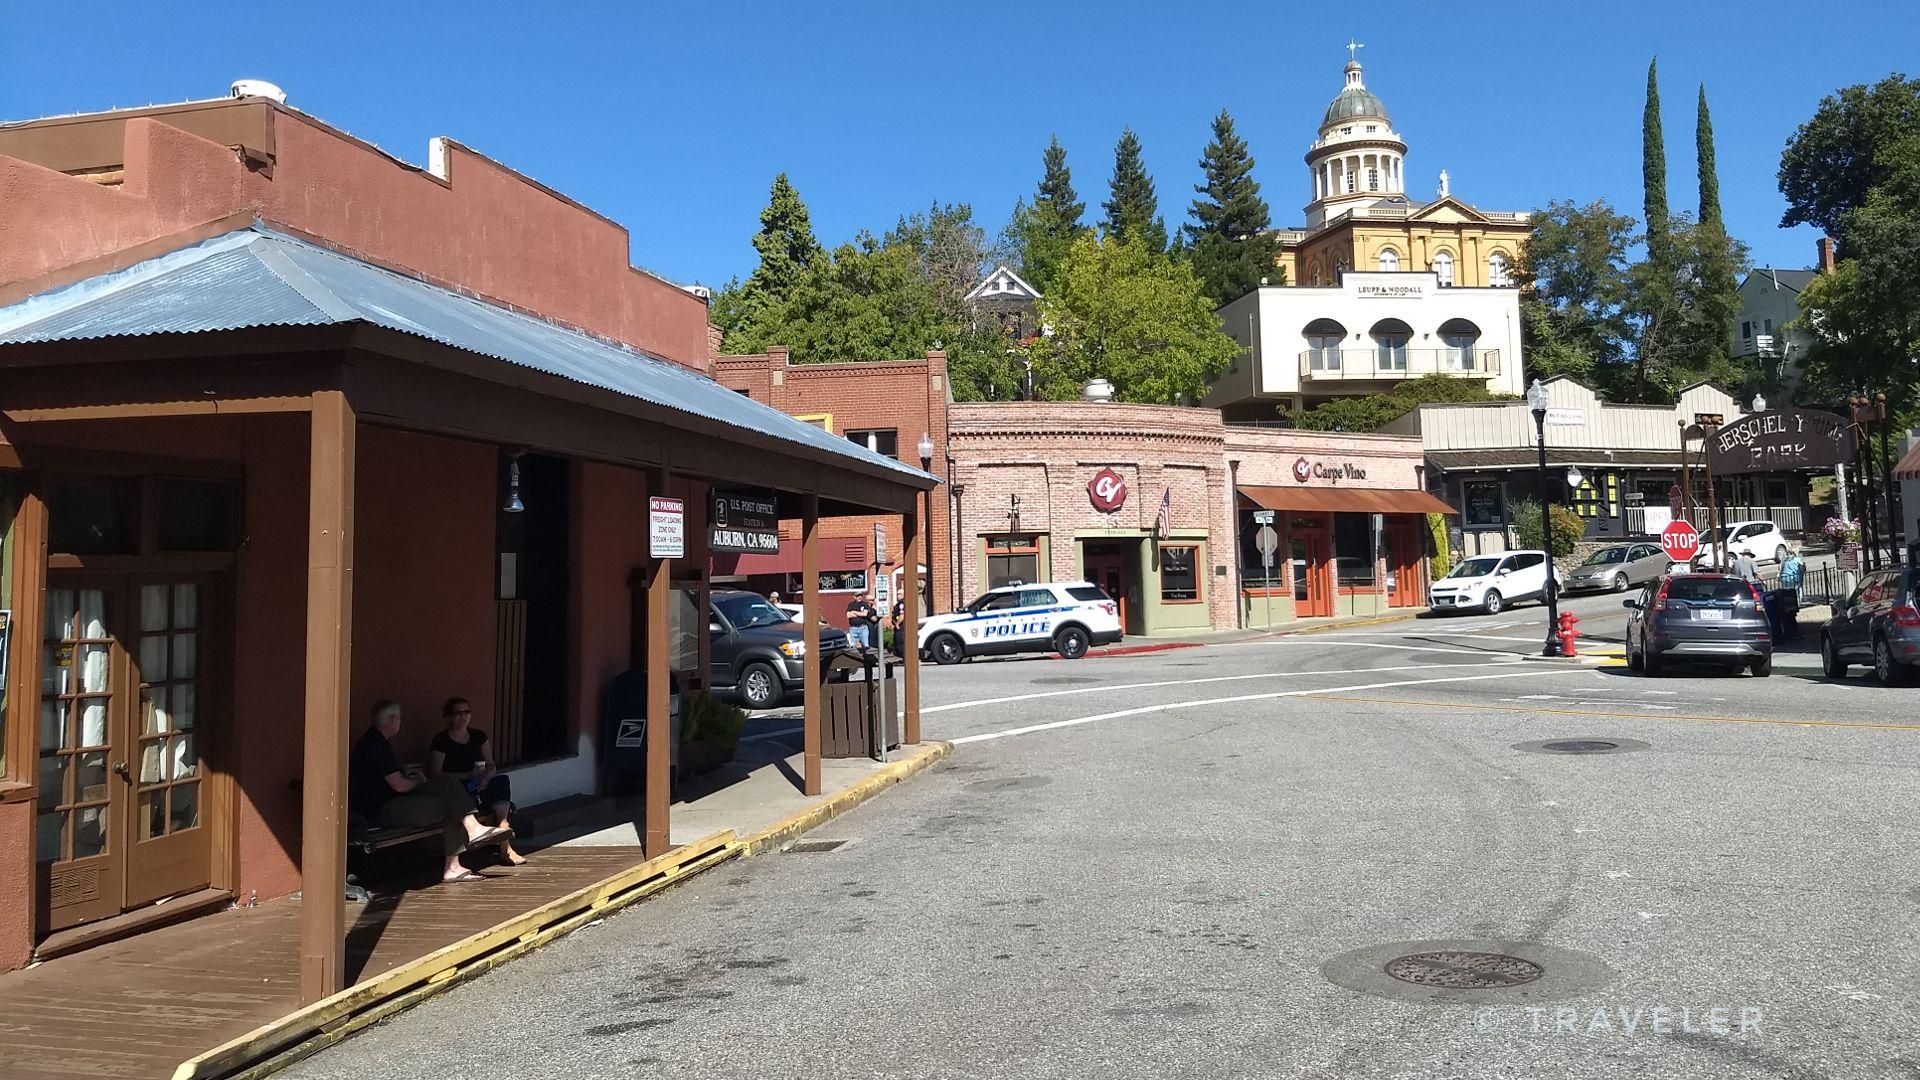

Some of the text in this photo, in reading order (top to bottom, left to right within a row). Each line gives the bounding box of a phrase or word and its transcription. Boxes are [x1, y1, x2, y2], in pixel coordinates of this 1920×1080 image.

[1719, 414, 1786, 454] HERSCHEL
[1313, 461, 1366, 484] Carpe Vino
[651, 500, 682, 511] NO PARKING
[741, 501, 755, 512] POST
[756, 503, 774, 515] OFFICE
[713, 530, 778, 549] AUBURN, CA 95604
[1663, 532, 1696, 549] STOP
[984, 621, 1051, 638] POLICE
